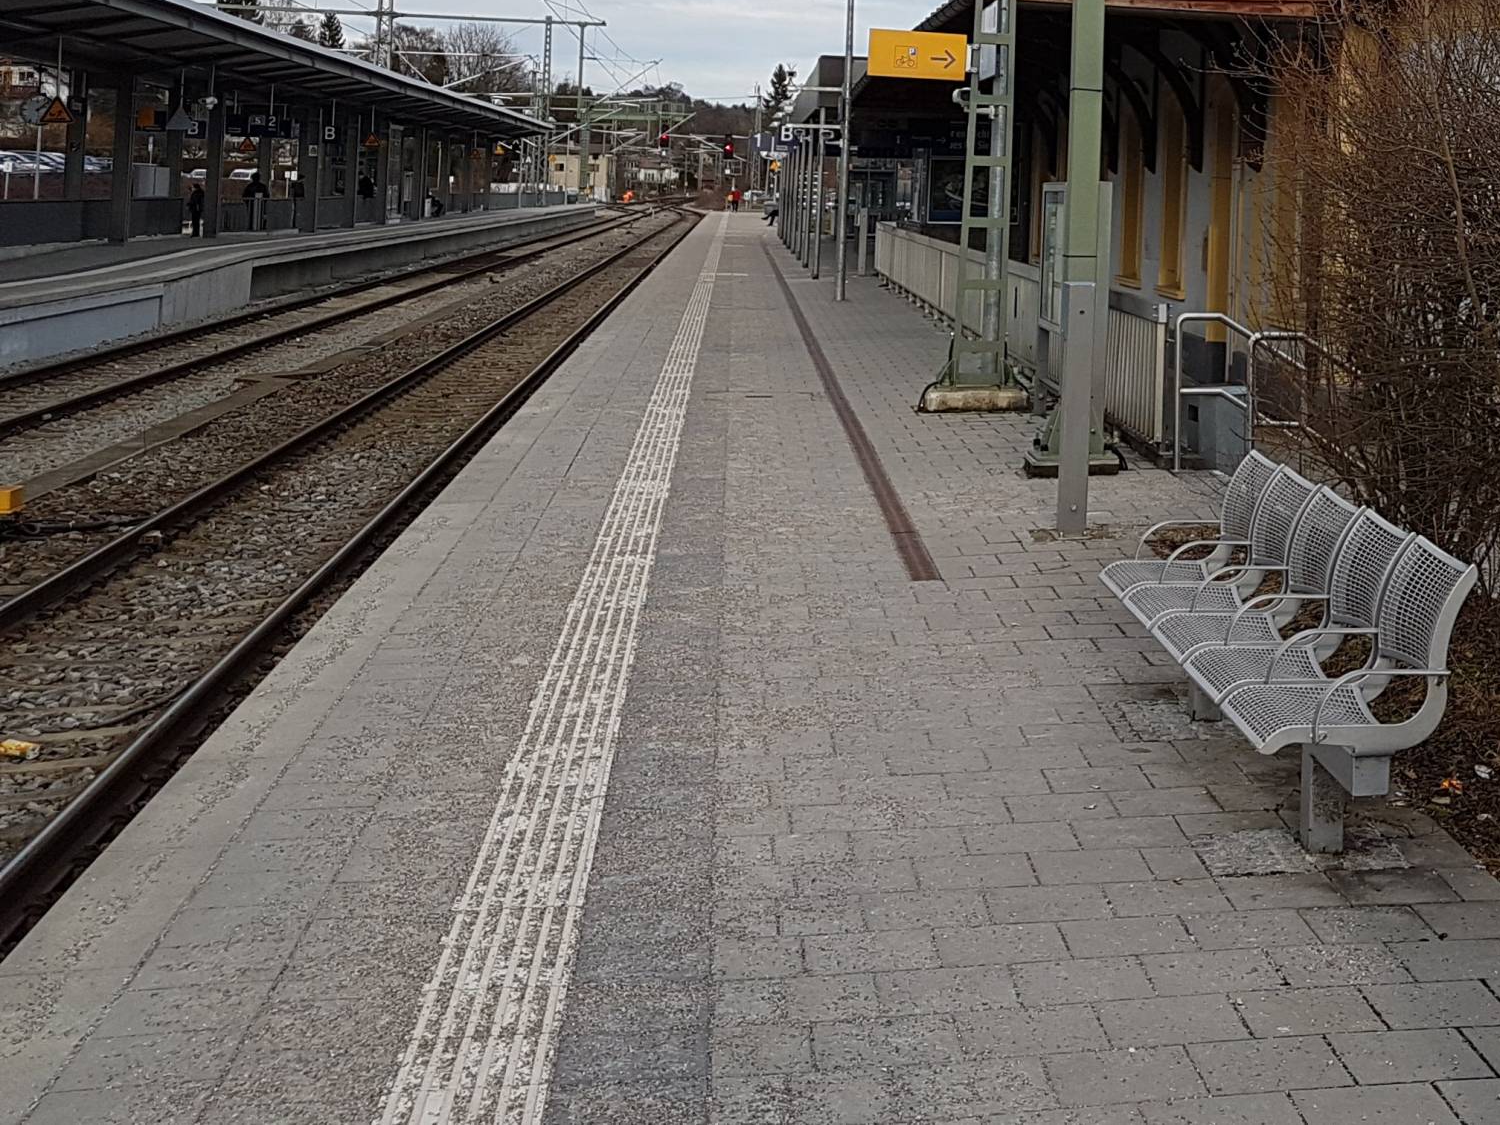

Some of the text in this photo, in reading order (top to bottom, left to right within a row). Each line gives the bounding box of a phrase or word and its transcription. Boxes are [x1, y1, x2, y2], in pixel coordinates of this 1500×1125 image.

[267, 116, 277, 127] 2
[324, 126, 336, 141] B
[753, 133, 761, 148] 1
[781, 125, 794, 142] B
